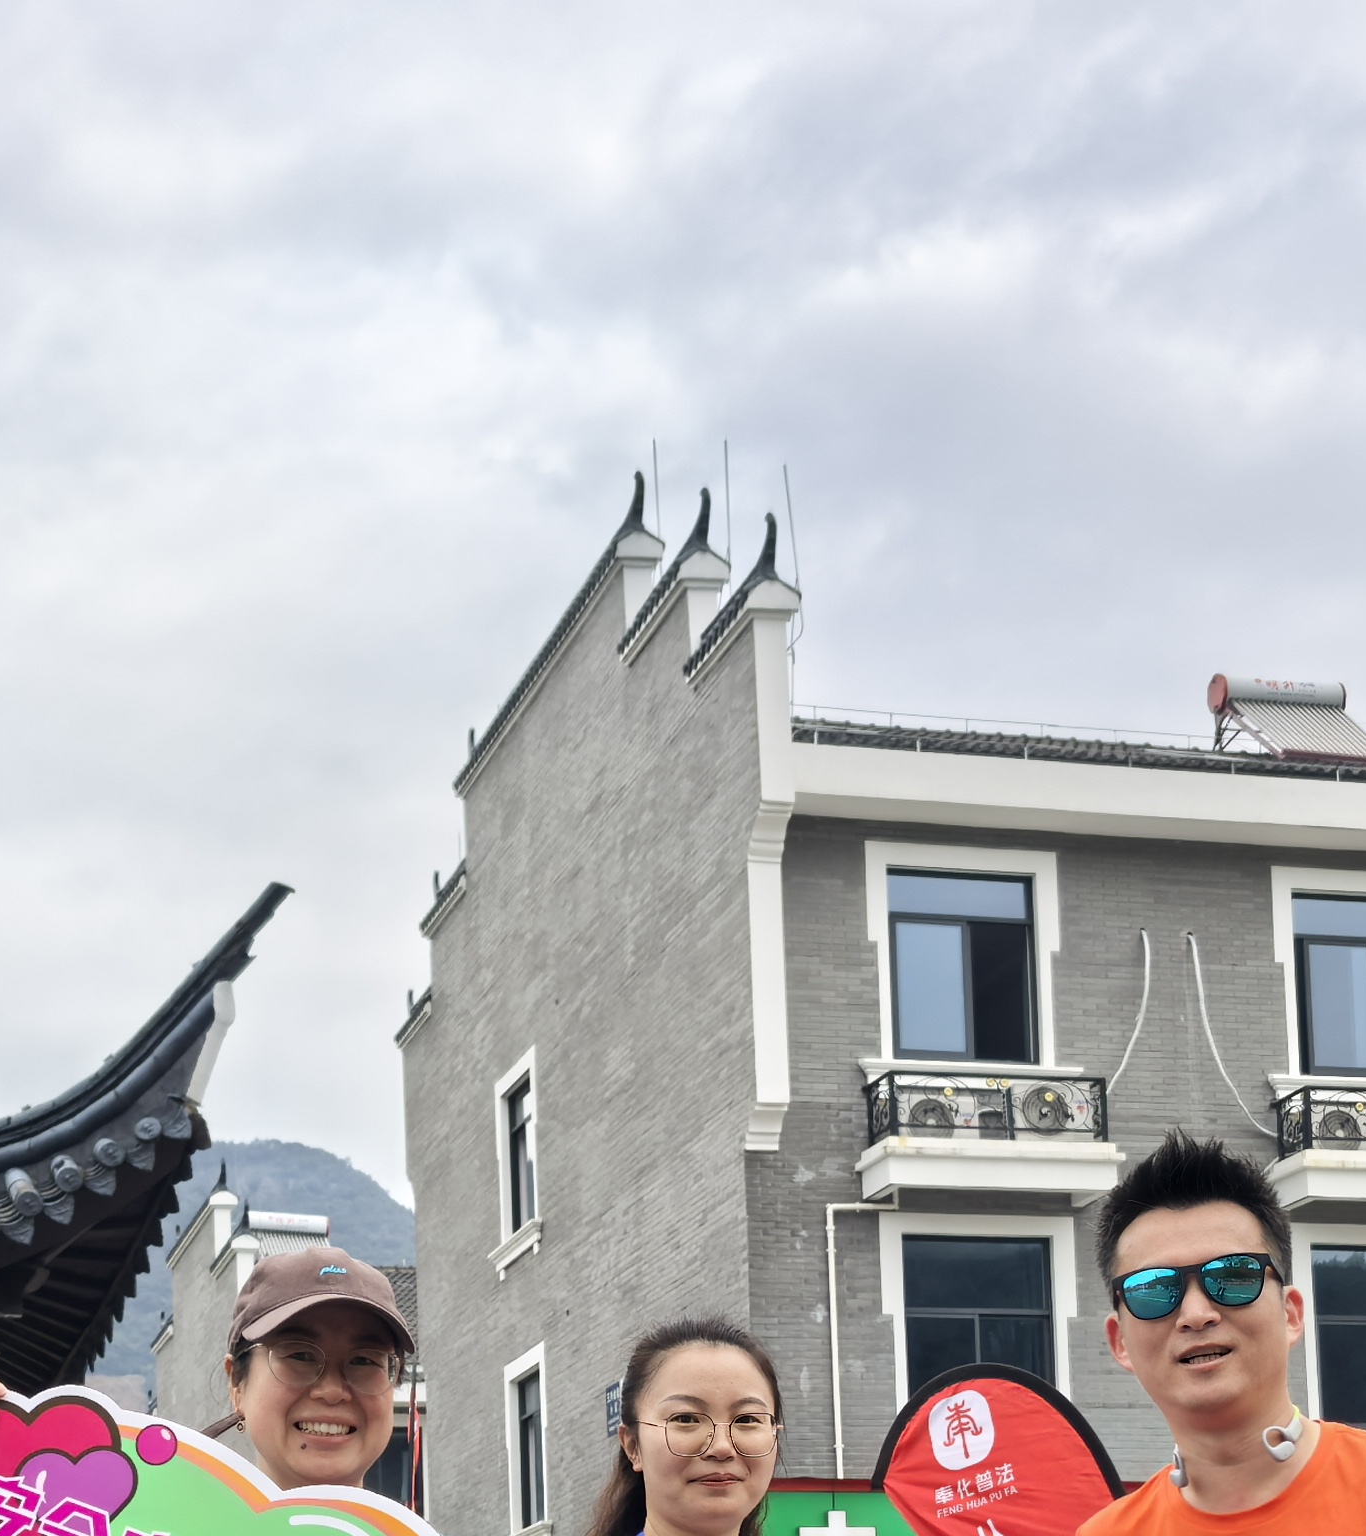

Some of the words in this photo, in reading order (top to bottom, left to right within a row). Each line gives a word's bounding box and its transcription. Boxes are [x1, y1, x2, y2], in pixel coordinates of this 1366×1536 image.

[935, 1463, 1015, 1504] 奉化普法
[937, 1503, 964, 1518] FENG
[966, 1497, 988, 1510] HUA
[990, 1492, 1003, 1503] PU
[1004, 1485, 1018, 1498] FA
